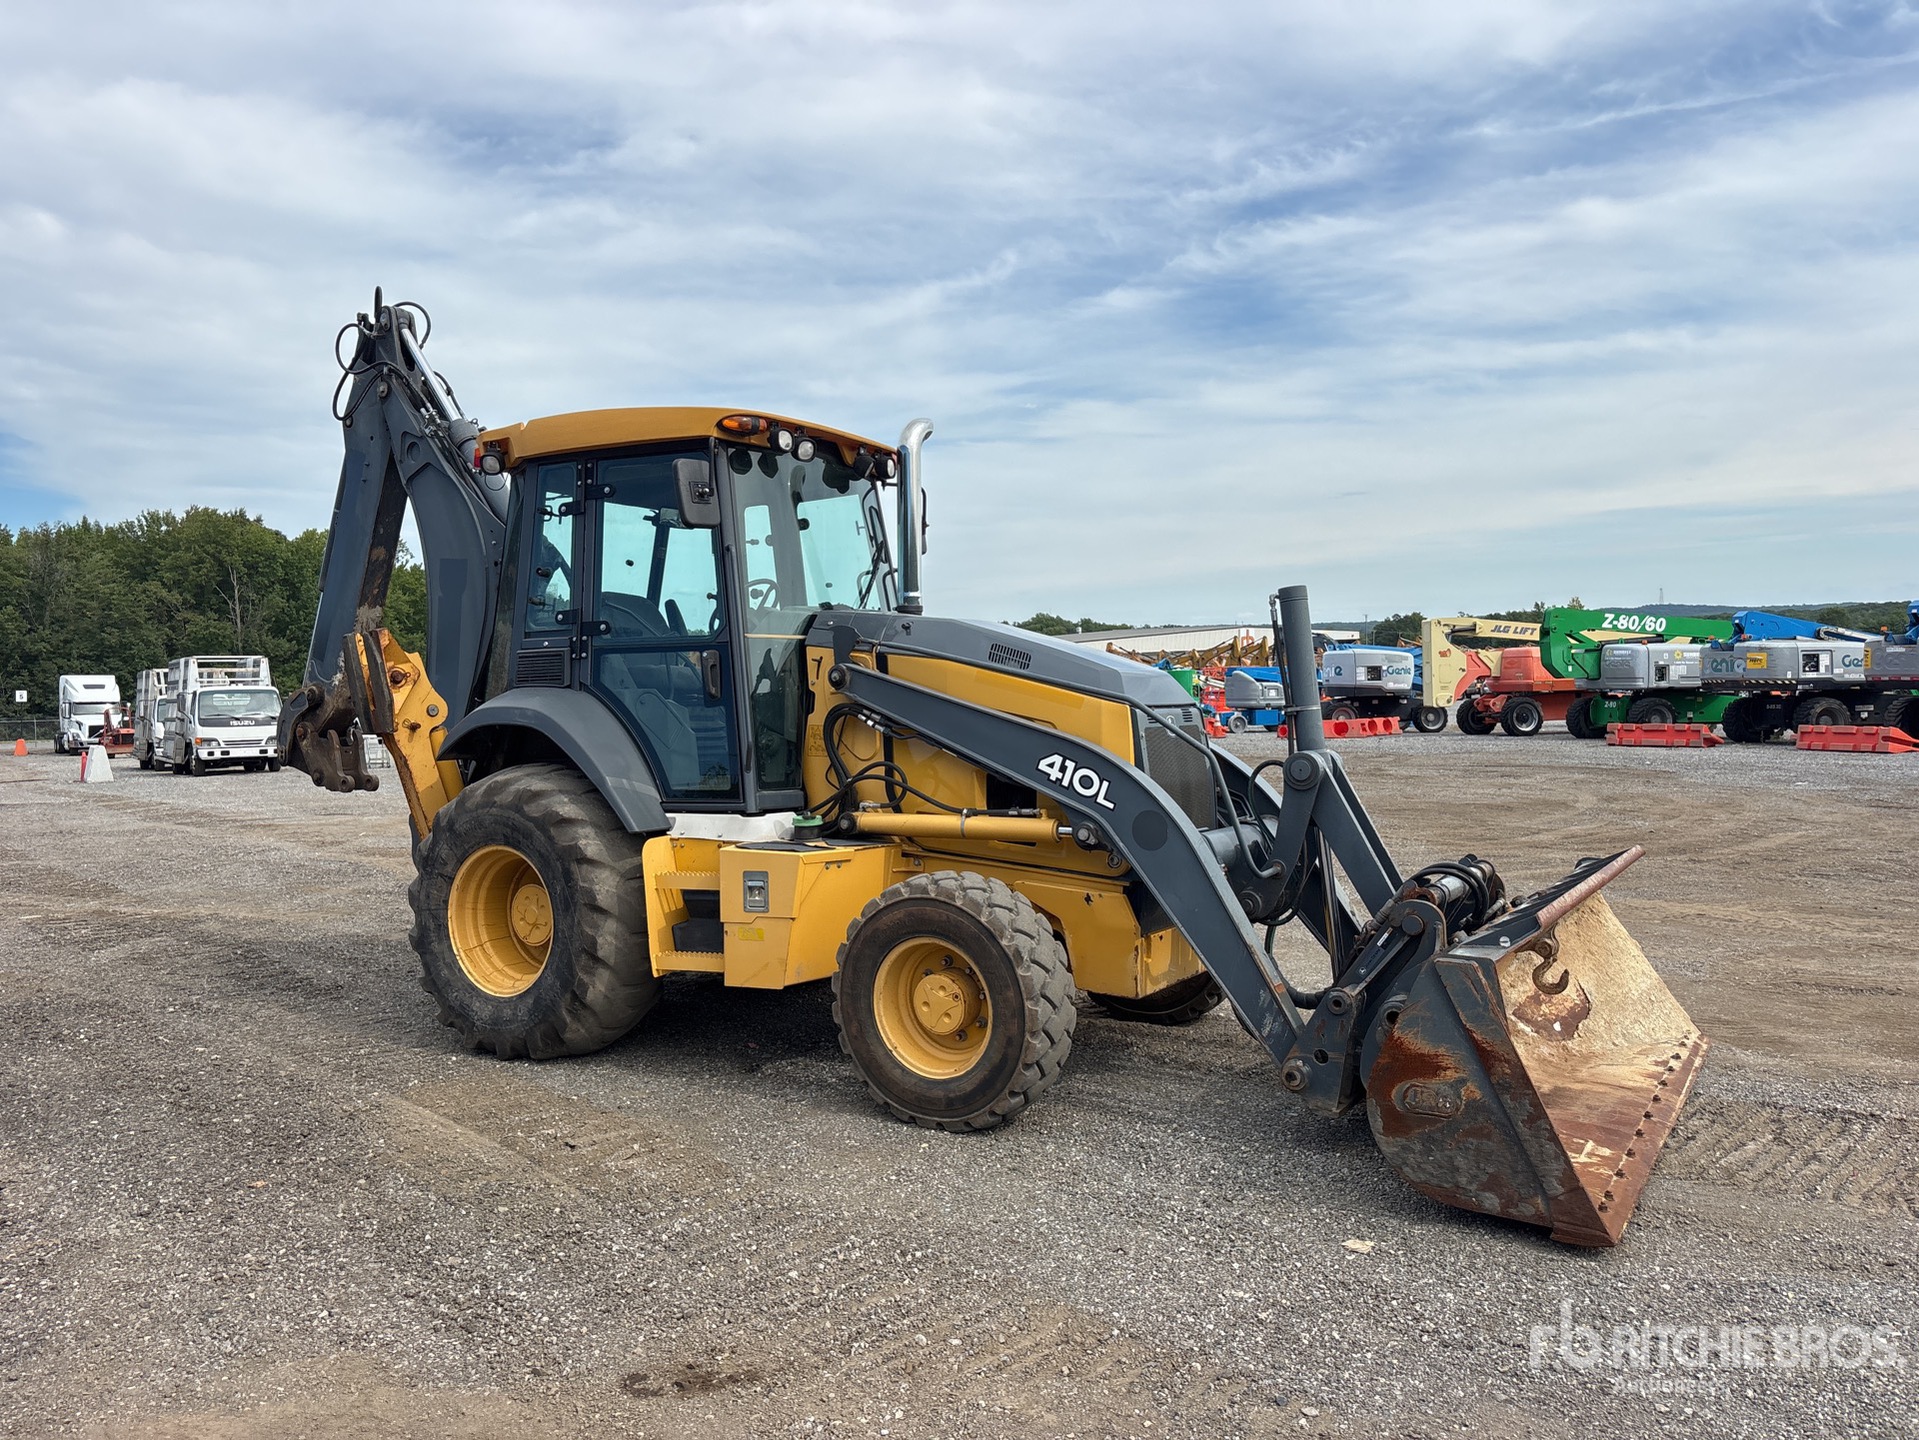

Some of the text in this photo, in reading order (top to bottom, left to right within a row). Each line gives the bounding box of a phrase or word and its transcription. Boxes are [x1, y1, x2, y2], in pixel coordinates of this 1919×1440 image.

[1490, 624, 1537, 636] JLG LIFT
[1601, 613, 1667, 632] Z-80/60
[1386, 665, 1412, 676] Genie
[1037, 753, 1115, 810] 410L
